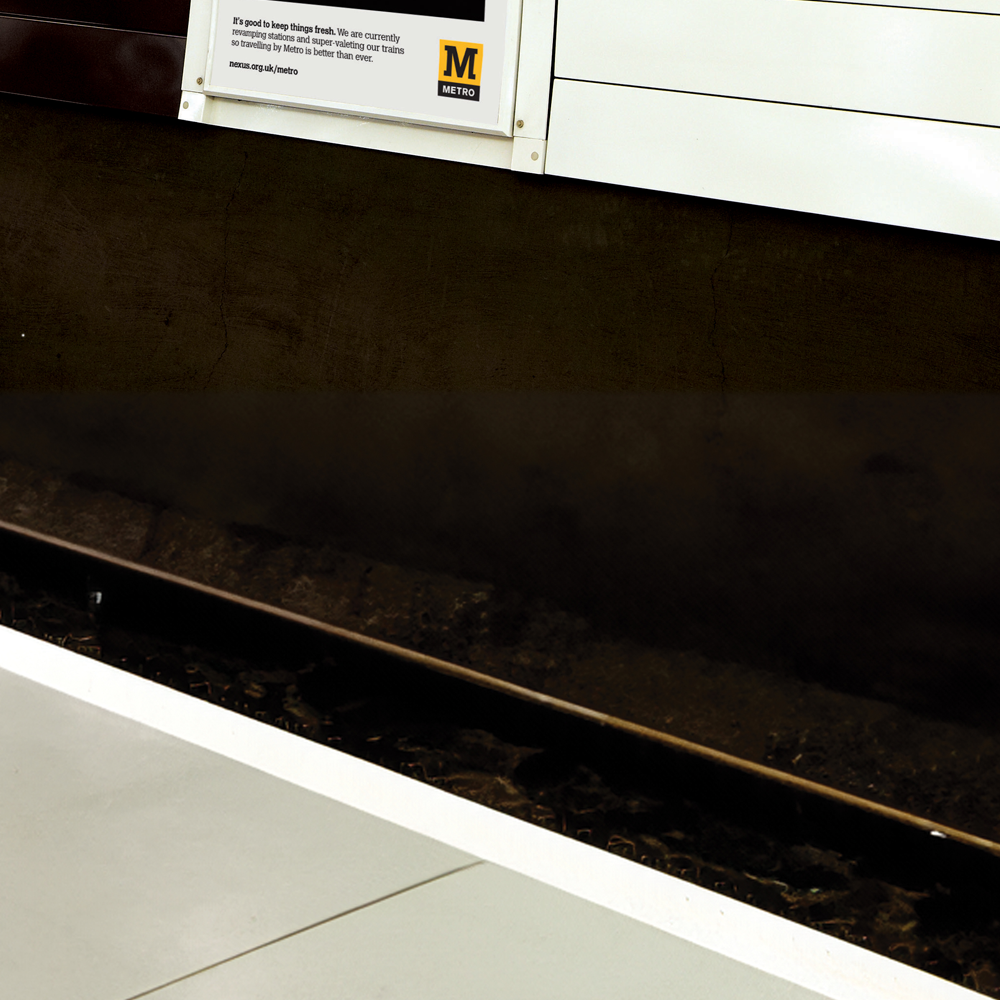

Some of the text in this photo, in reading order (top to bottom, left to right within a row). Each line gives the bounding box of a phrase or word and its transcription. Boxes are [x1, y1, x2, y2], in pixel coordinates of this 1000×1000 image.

[232, 29, 266, 40] revamping
[268, 32, 295, 42] stations
[296, 36, 310, 44] and
[312, 38, 364, 51] super-valeting
[382, 44, 404, 54] trains
[272, 21, 288, 32] keep
[290, 23, 313, 34] things
[314, 25, 336, 36] fresh.
[337, 28, 349, 37] We
[364, 32, 400, 44] currently
[240, 40, 272, 51] travelling
[273, 43, 282, 53] by
[284, 44, 304, 54] Metro
[305, 46, 312, 55] is
[314, 47, 335, 58] better
[336, 50, 353, 60] than
[355, 54, 373, 62] ever.
[229, 60, 298, 75] nexus.org.uk/metro
[444, 45, 478, 80] M
[442, 85, 475, 97] METRO
